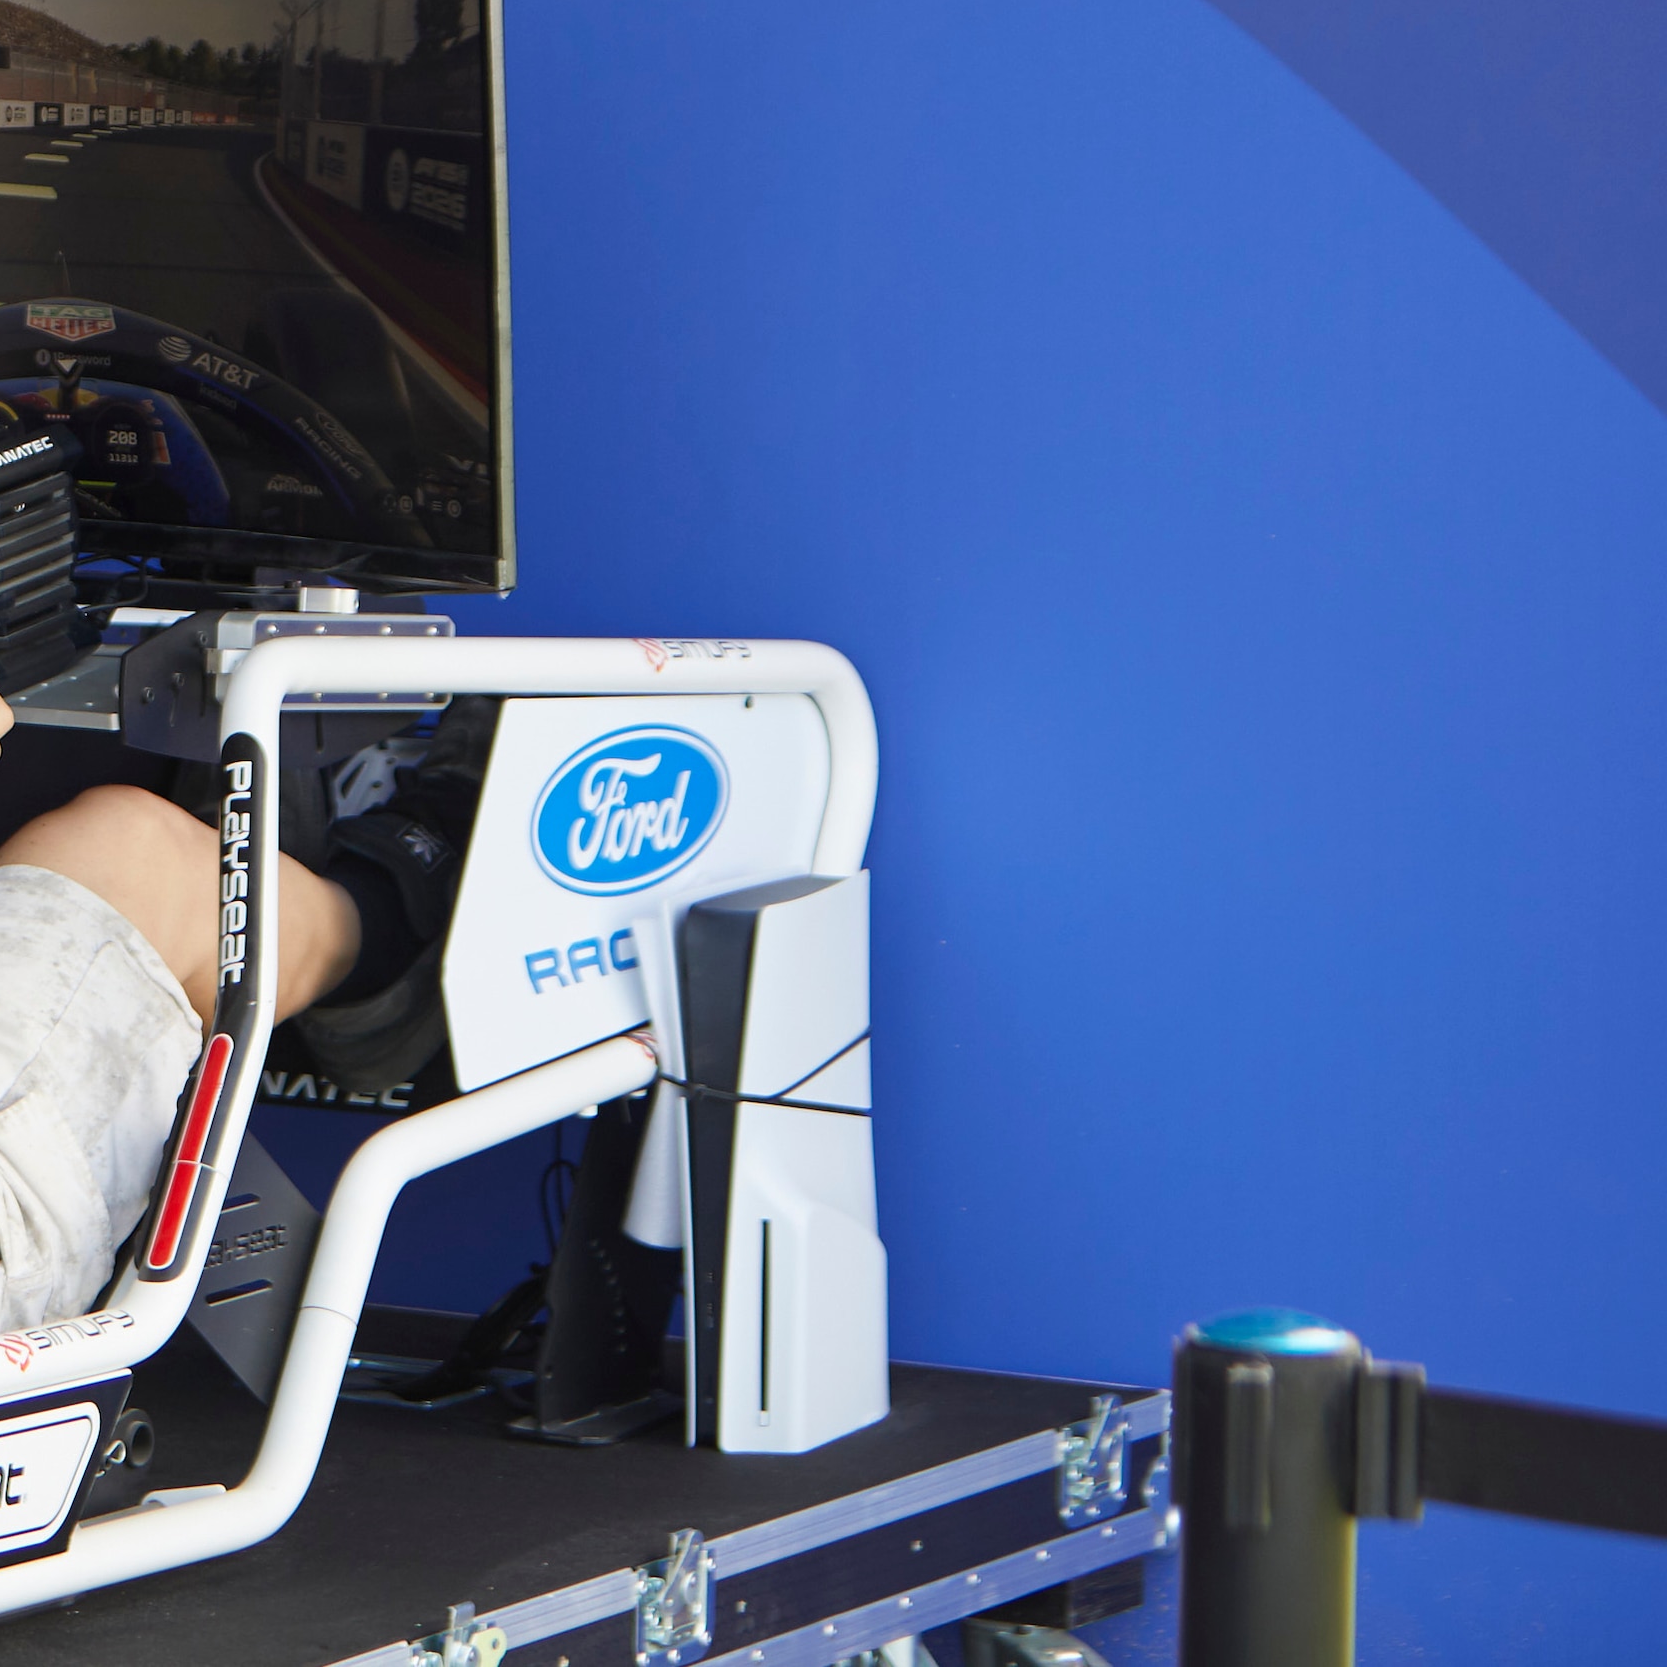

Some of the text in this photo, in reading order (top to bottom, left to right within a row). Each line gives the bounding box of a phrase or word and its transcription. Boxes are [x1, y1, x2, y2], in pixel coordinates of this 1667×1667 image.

[29, 317, 116, 332] HEUER
[39, 305, 106, 318] TAG
[192, 352, 260, 391] AT&T
[568, 751, 692, 871] Ford
[525, 926, 639, 995] RAC
